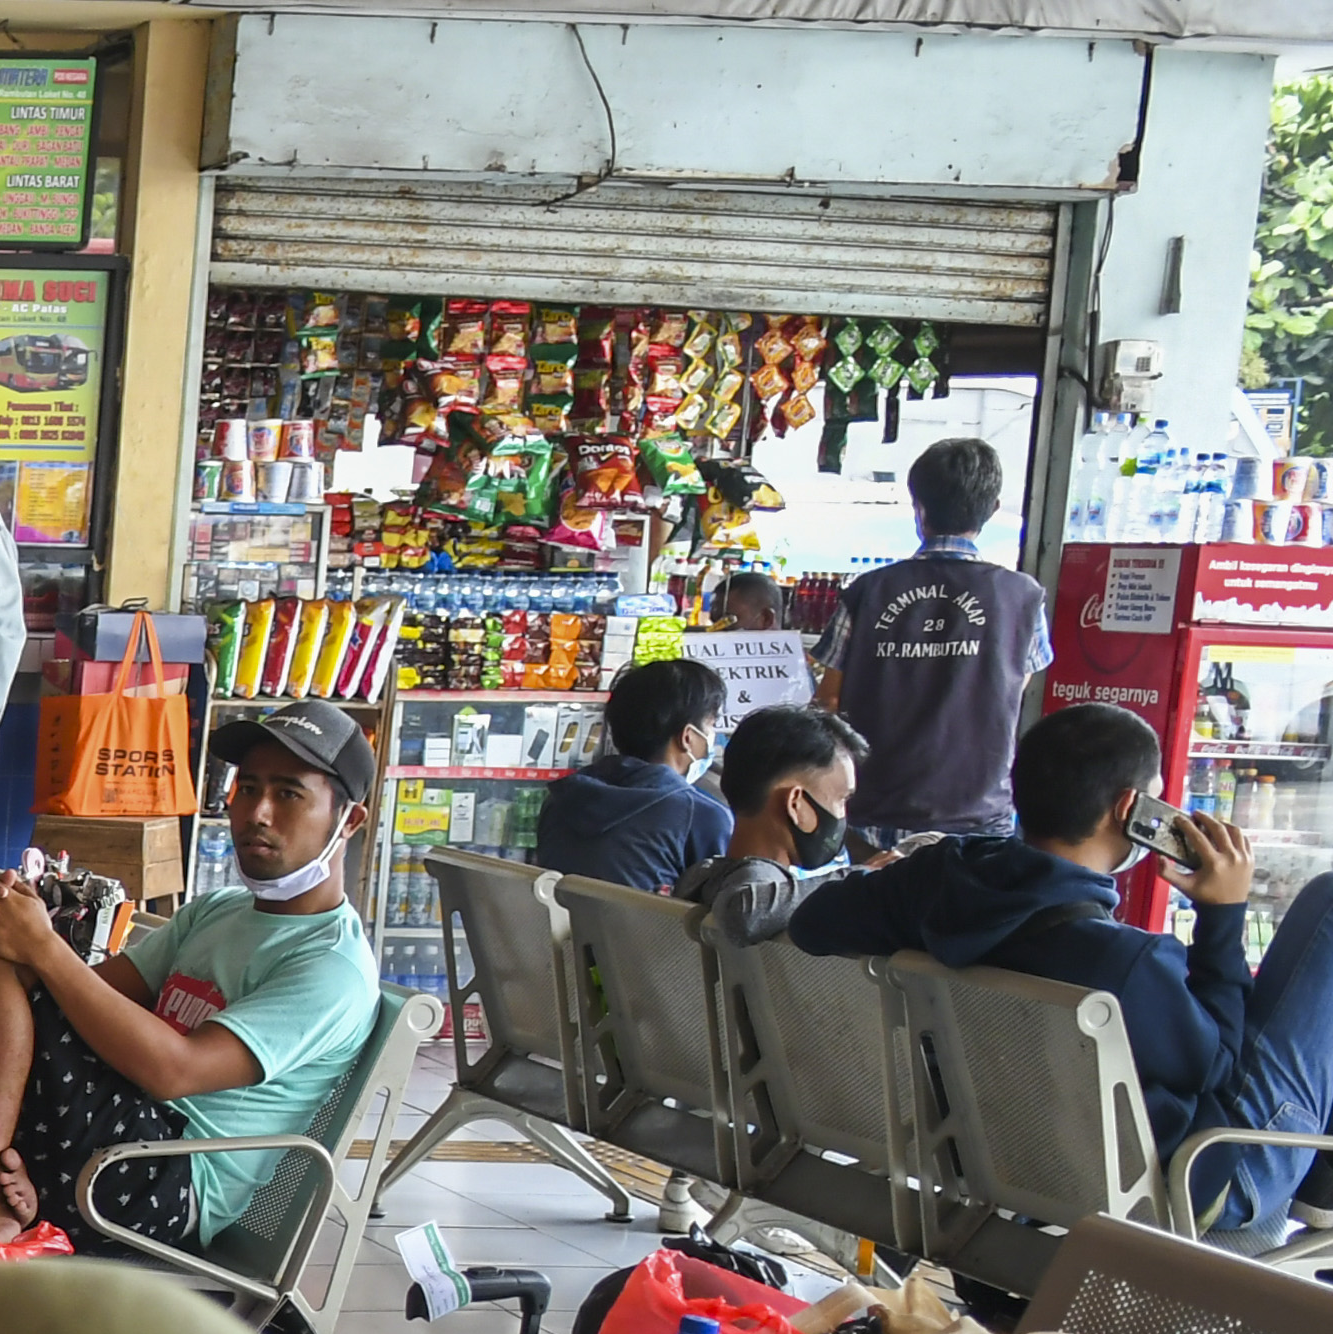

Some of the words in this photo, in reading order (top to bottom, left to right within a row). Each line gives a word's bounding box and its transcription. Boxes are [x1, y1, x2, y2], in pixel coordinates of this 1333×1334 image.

[11, 107, 46, 119] LINTAS
[50, 107, 85, 120] TIMUR
[43, 281, 96, 303] SUCI
[535, 361, 567, 374] Taro
[531, 404, 562, 417] Taro
[579, 444, 630, 456] Doritos
[875, 584, 948, 631] TERMINAL
[953, 591, 986, 627] AKAP
[923, 619, 945, 632] 28
[735, 642, 794, 655] PULSA
[877, 640, 980, 658] KP.RAMBUTAN
[737, 690, 751, 703] &
[1052, 681, 1090, 700] teguk
[1095, 686, 1159, 707] segarnya
